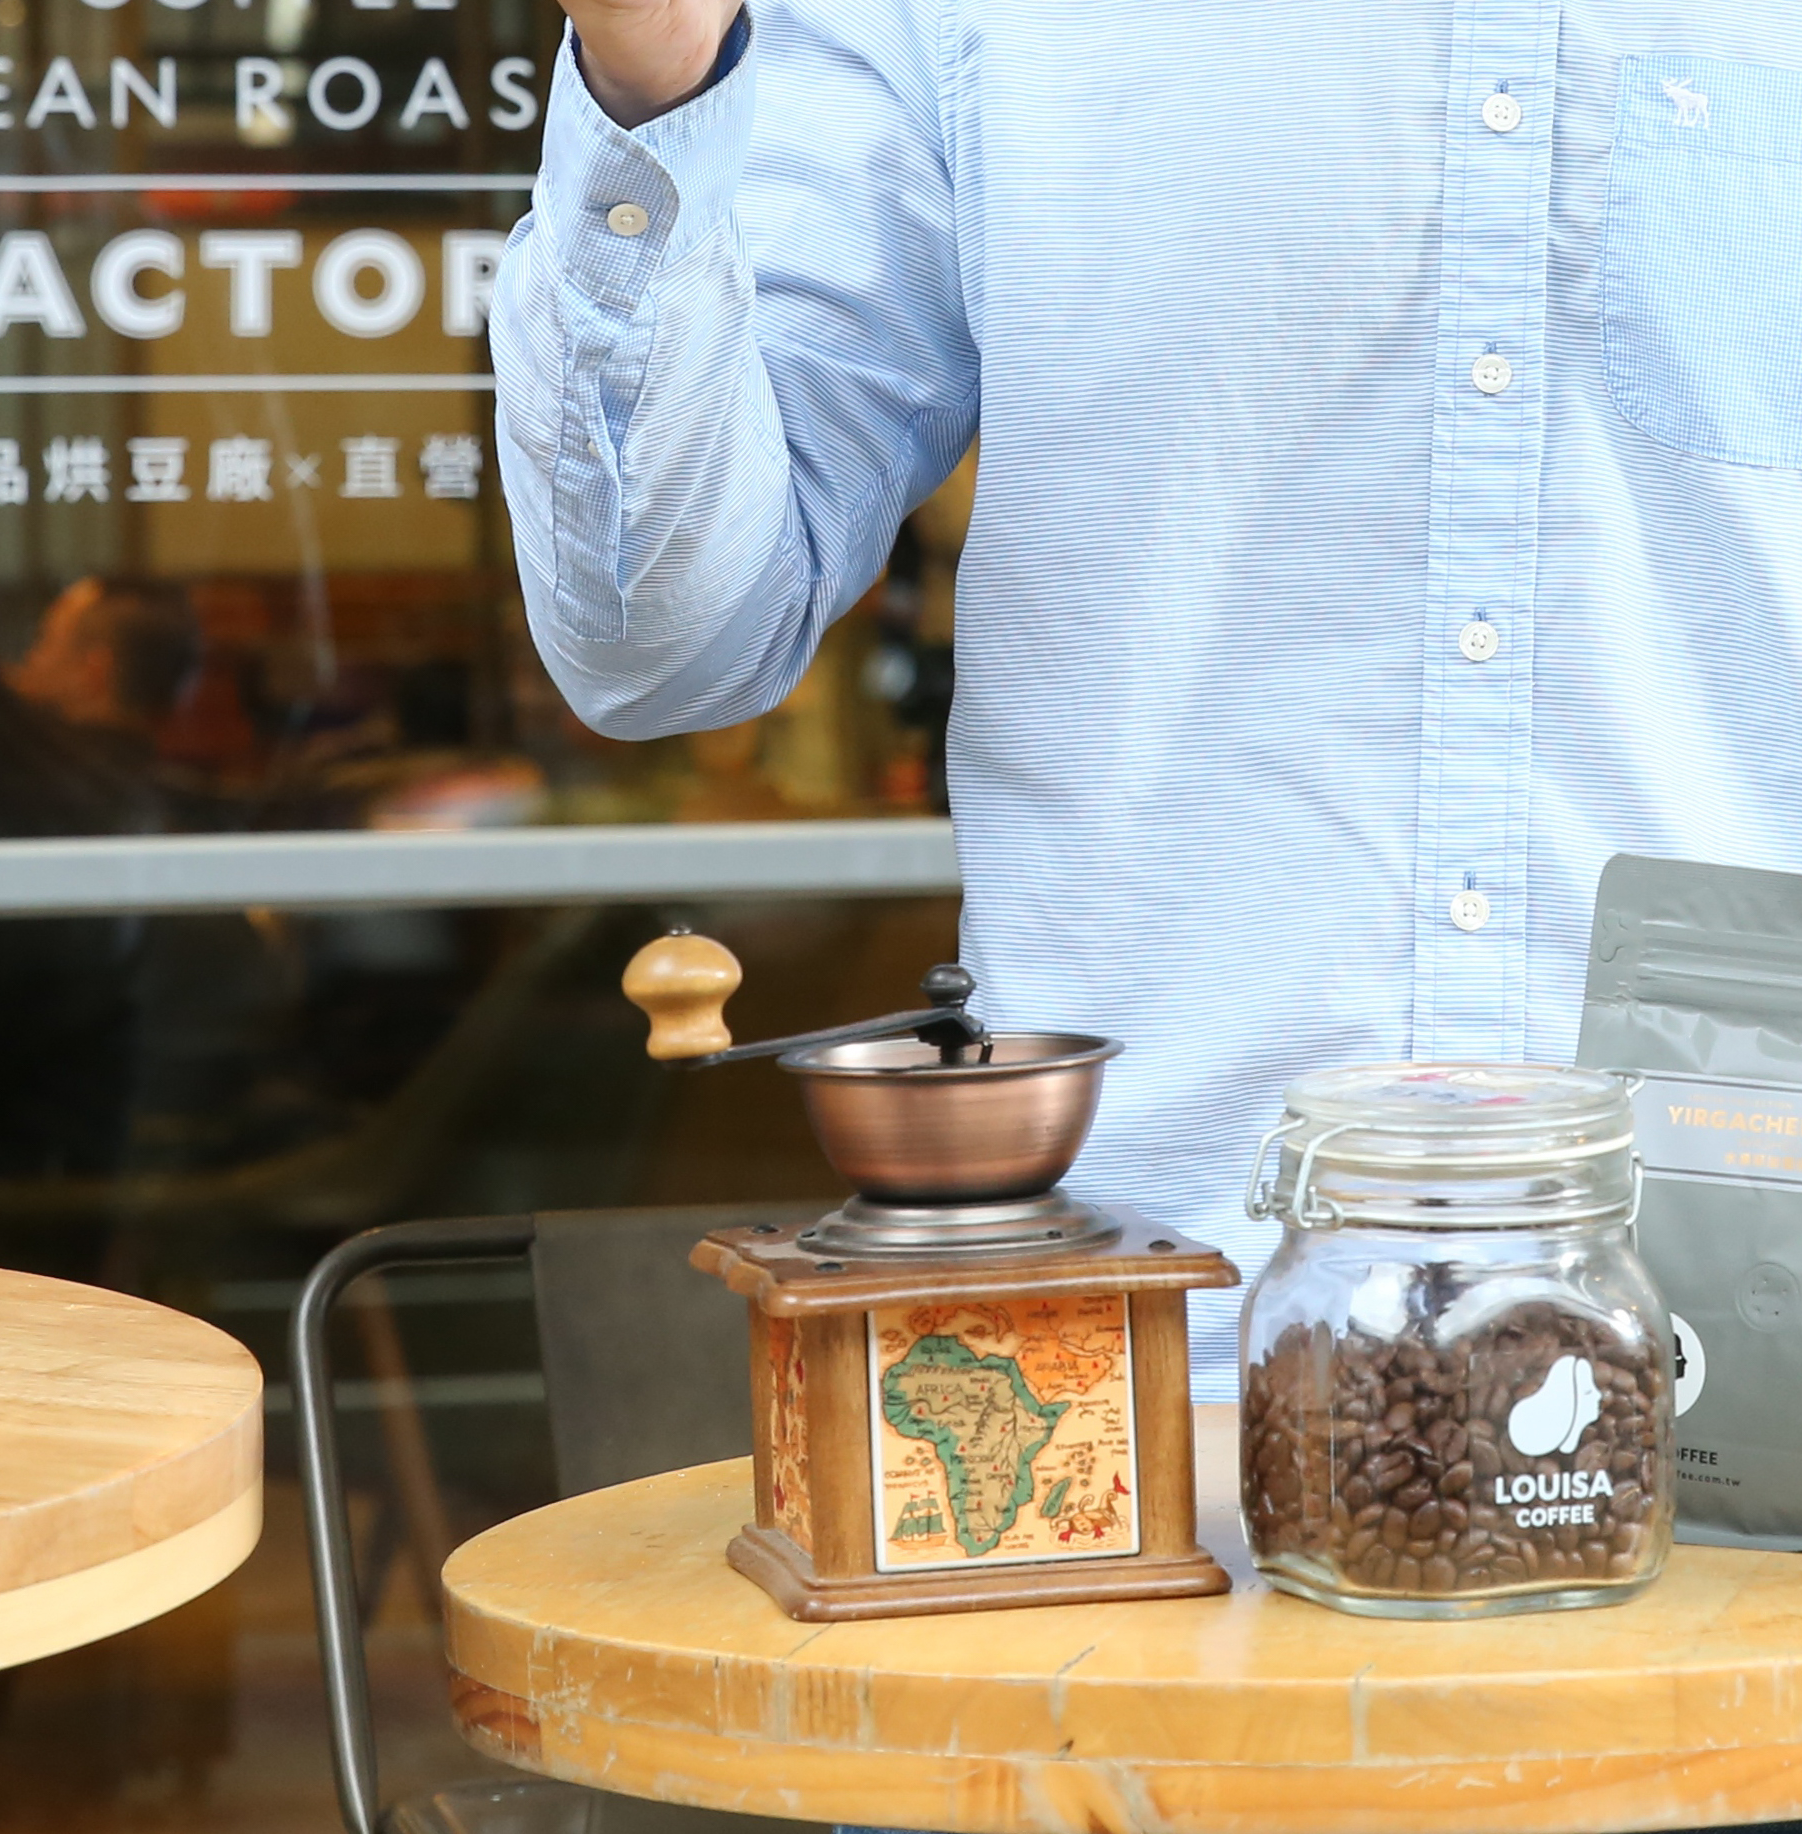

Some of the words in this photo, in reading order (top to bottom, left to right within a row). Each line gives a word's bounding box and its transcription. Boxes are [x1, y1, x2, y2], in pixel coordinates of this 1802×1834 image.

[235, 55, 539, 131] ROAS
[915, 1382, 964, 1396] AFRICA
[1495, 1469, 1614, 1505] LOUISA
[1515, 1503, 1595, 1528] COFFEE
